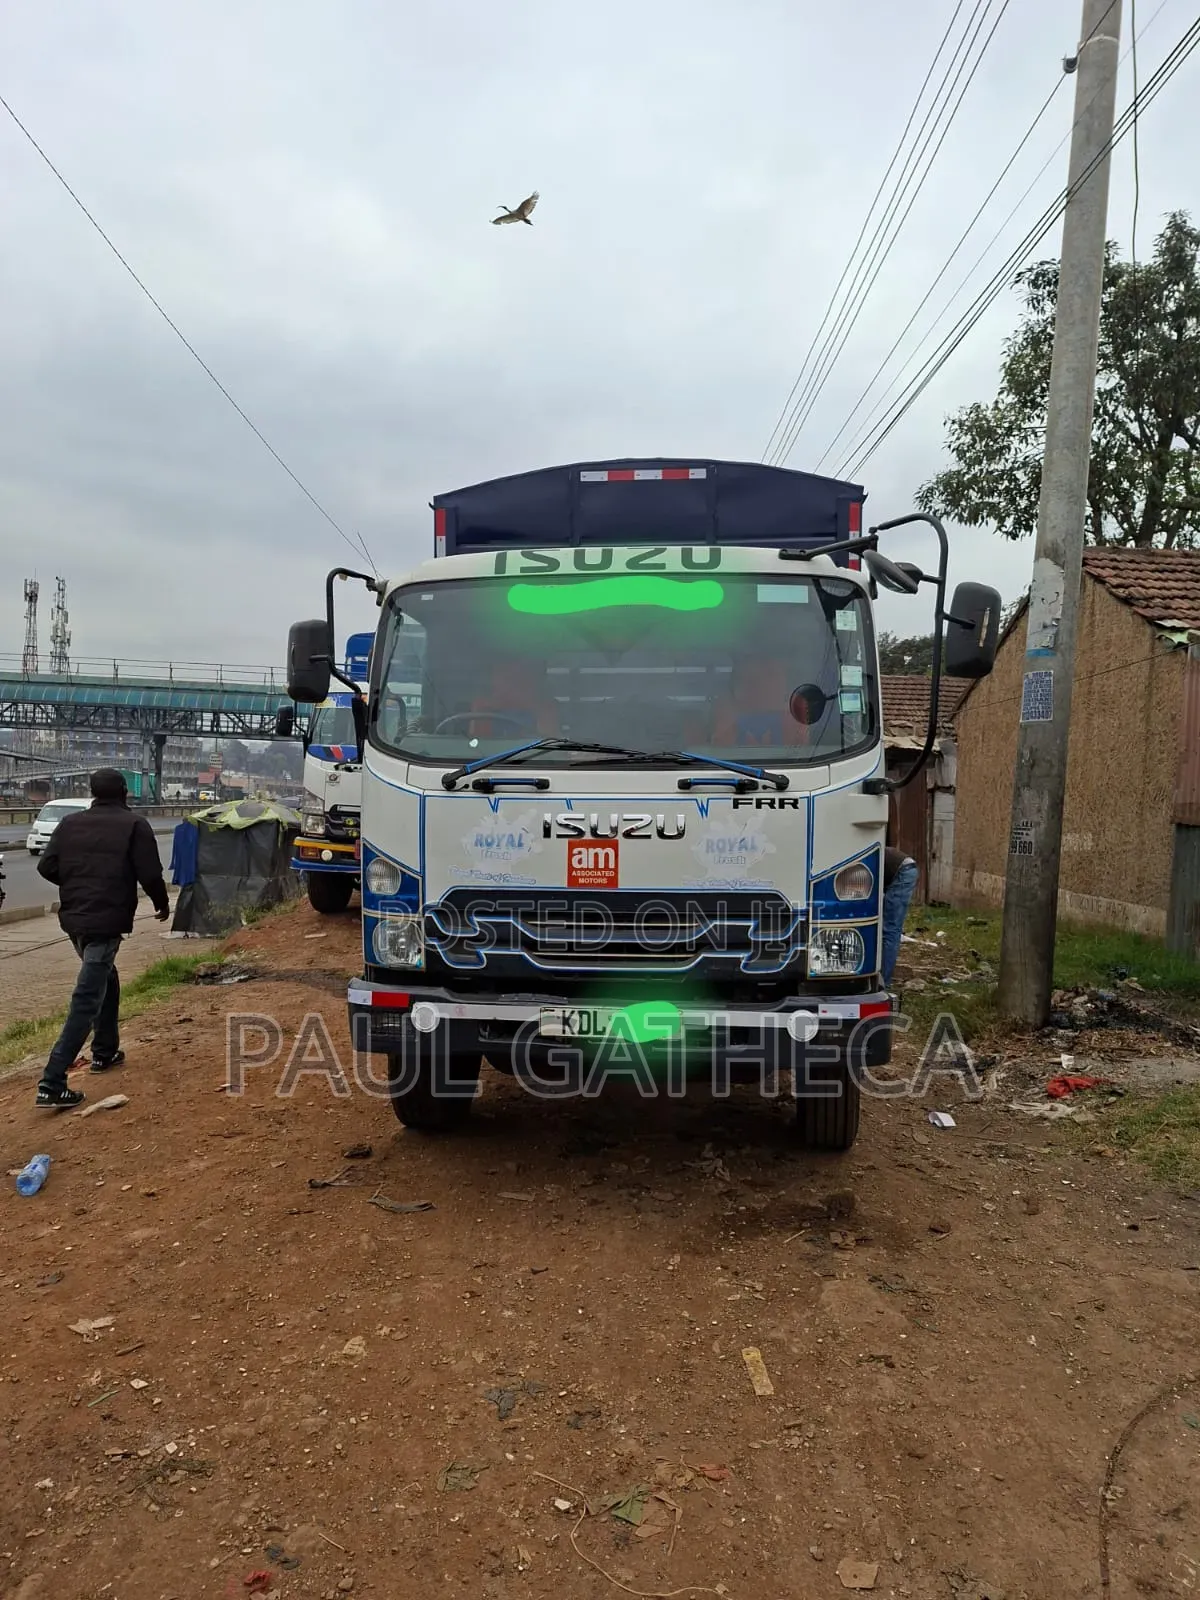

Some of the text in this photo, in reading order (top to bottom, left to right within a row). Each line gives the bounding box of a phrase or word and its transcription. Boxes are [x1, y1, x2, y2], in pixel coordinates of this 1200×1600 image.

[495, 547, 722, 575] ISUZU
[732, 797, 799, 810] FRR
[542, 813, 686, 840] ISUZU
[474, 832, 525, 848] ROYAL
[705, 836, 758, 854] ROYAL
[571, 847, 616, 869] am
[562, 1009, 607, 1036] KDL
